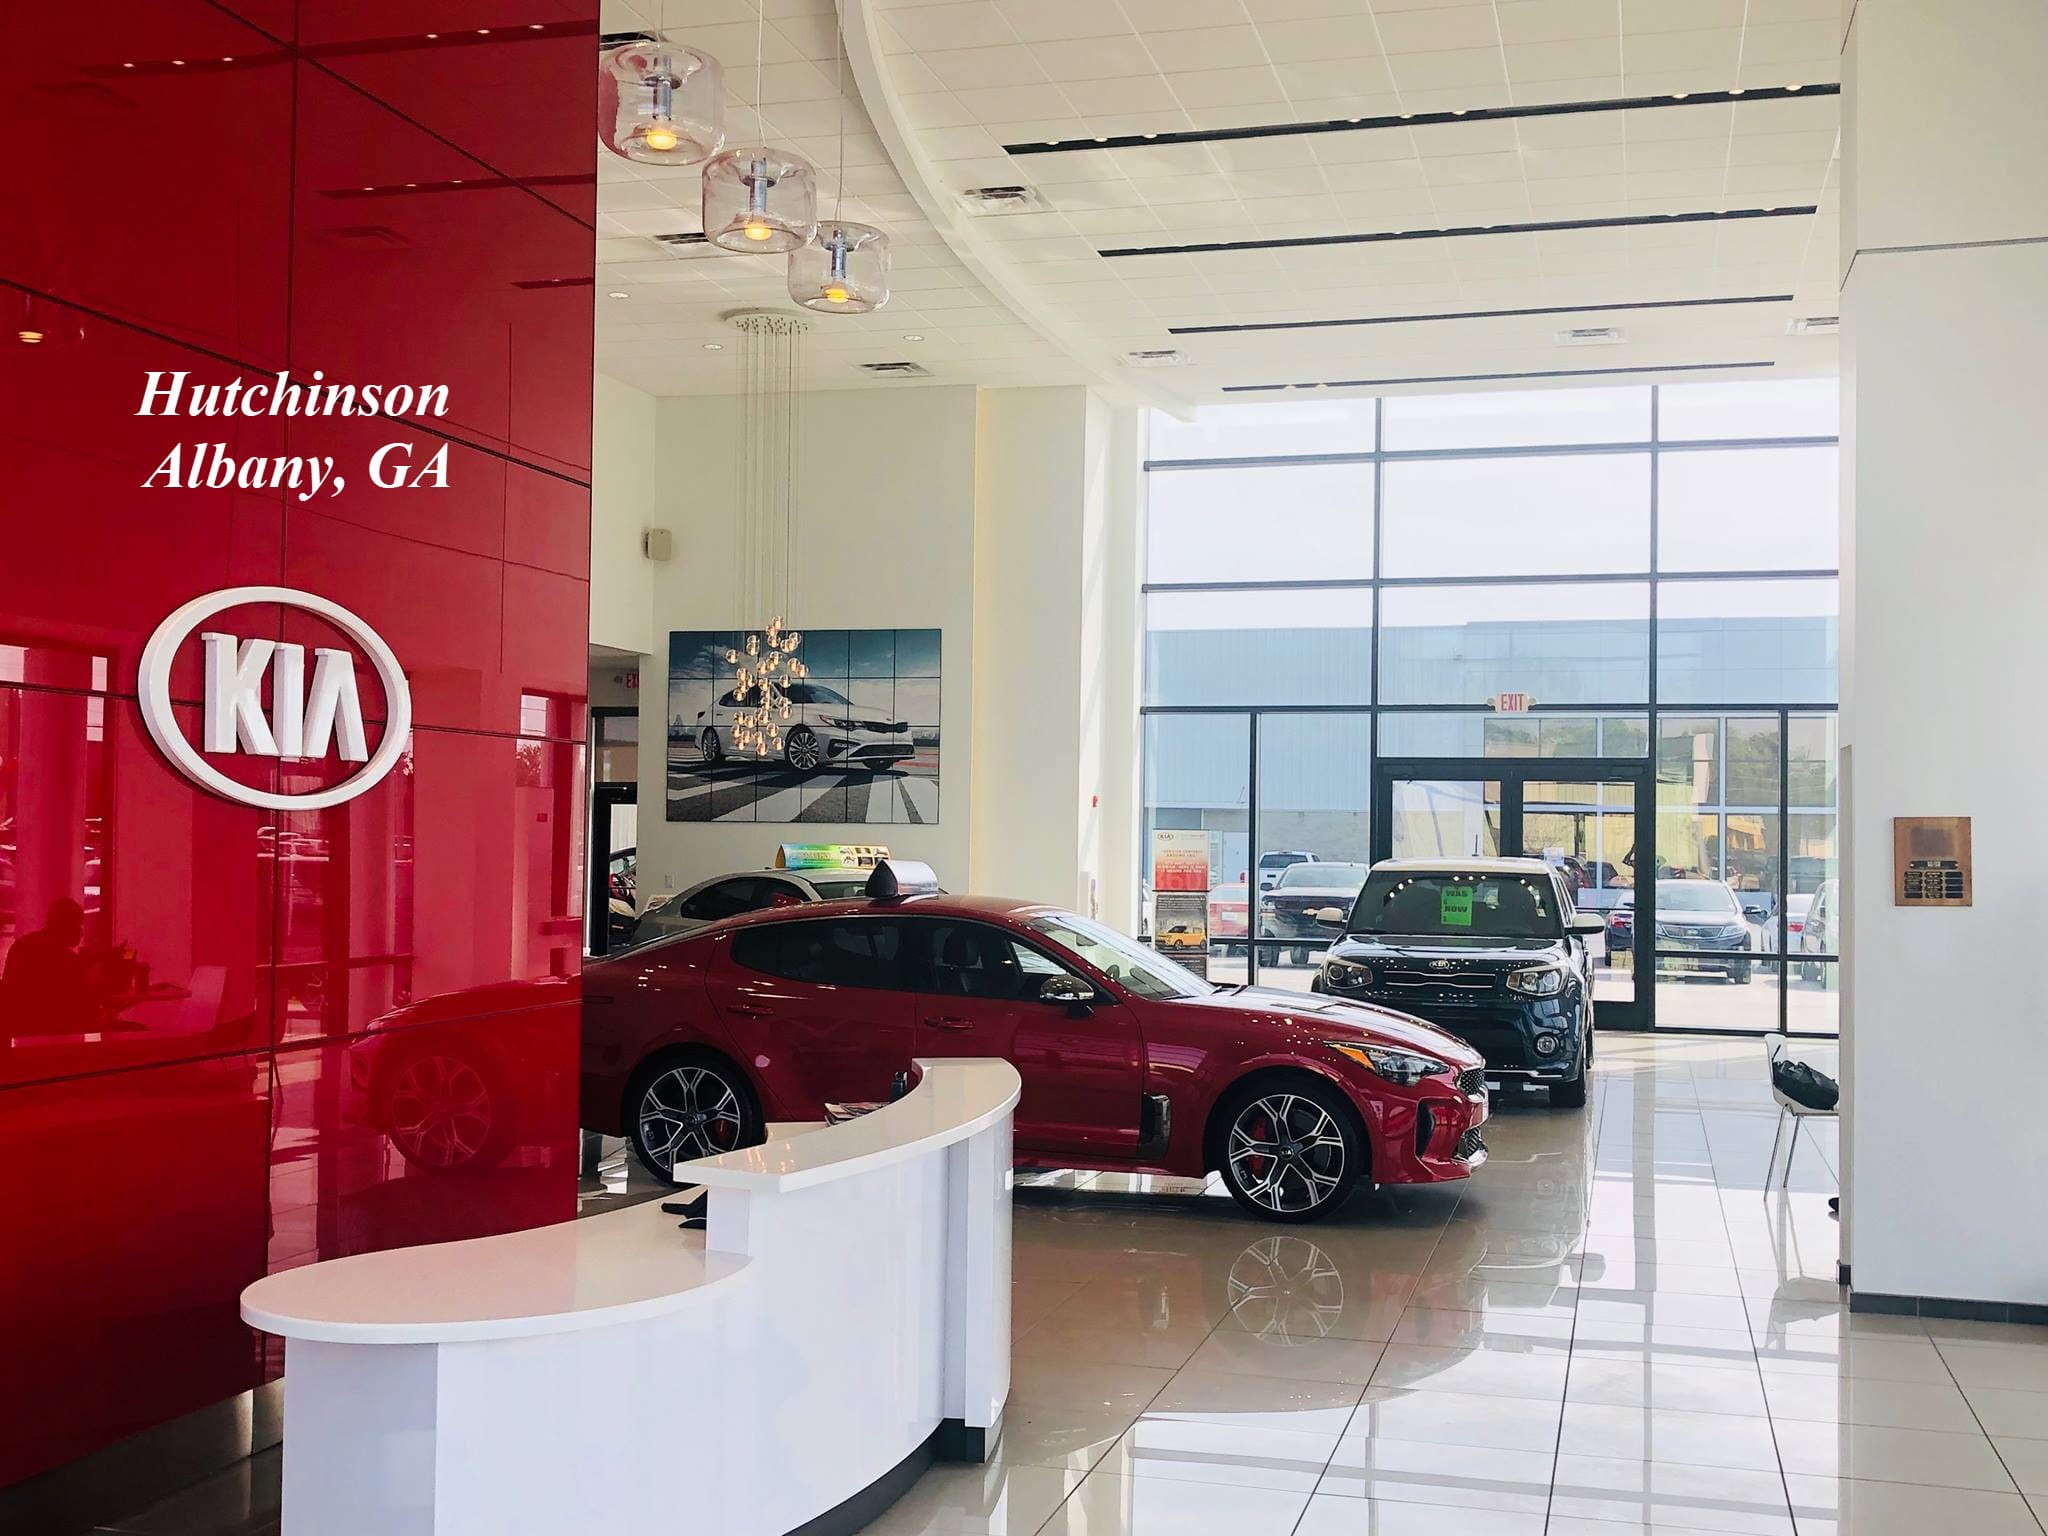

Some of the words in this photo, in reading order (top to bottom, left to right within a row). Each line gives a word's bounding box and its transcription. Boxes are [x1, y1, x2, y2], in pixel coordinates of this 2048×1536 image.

[202, 632, 368, 762] KIA
[1501, 693, 1524, 711] EXIT
[1444, 905, 1468, 913] NOW
